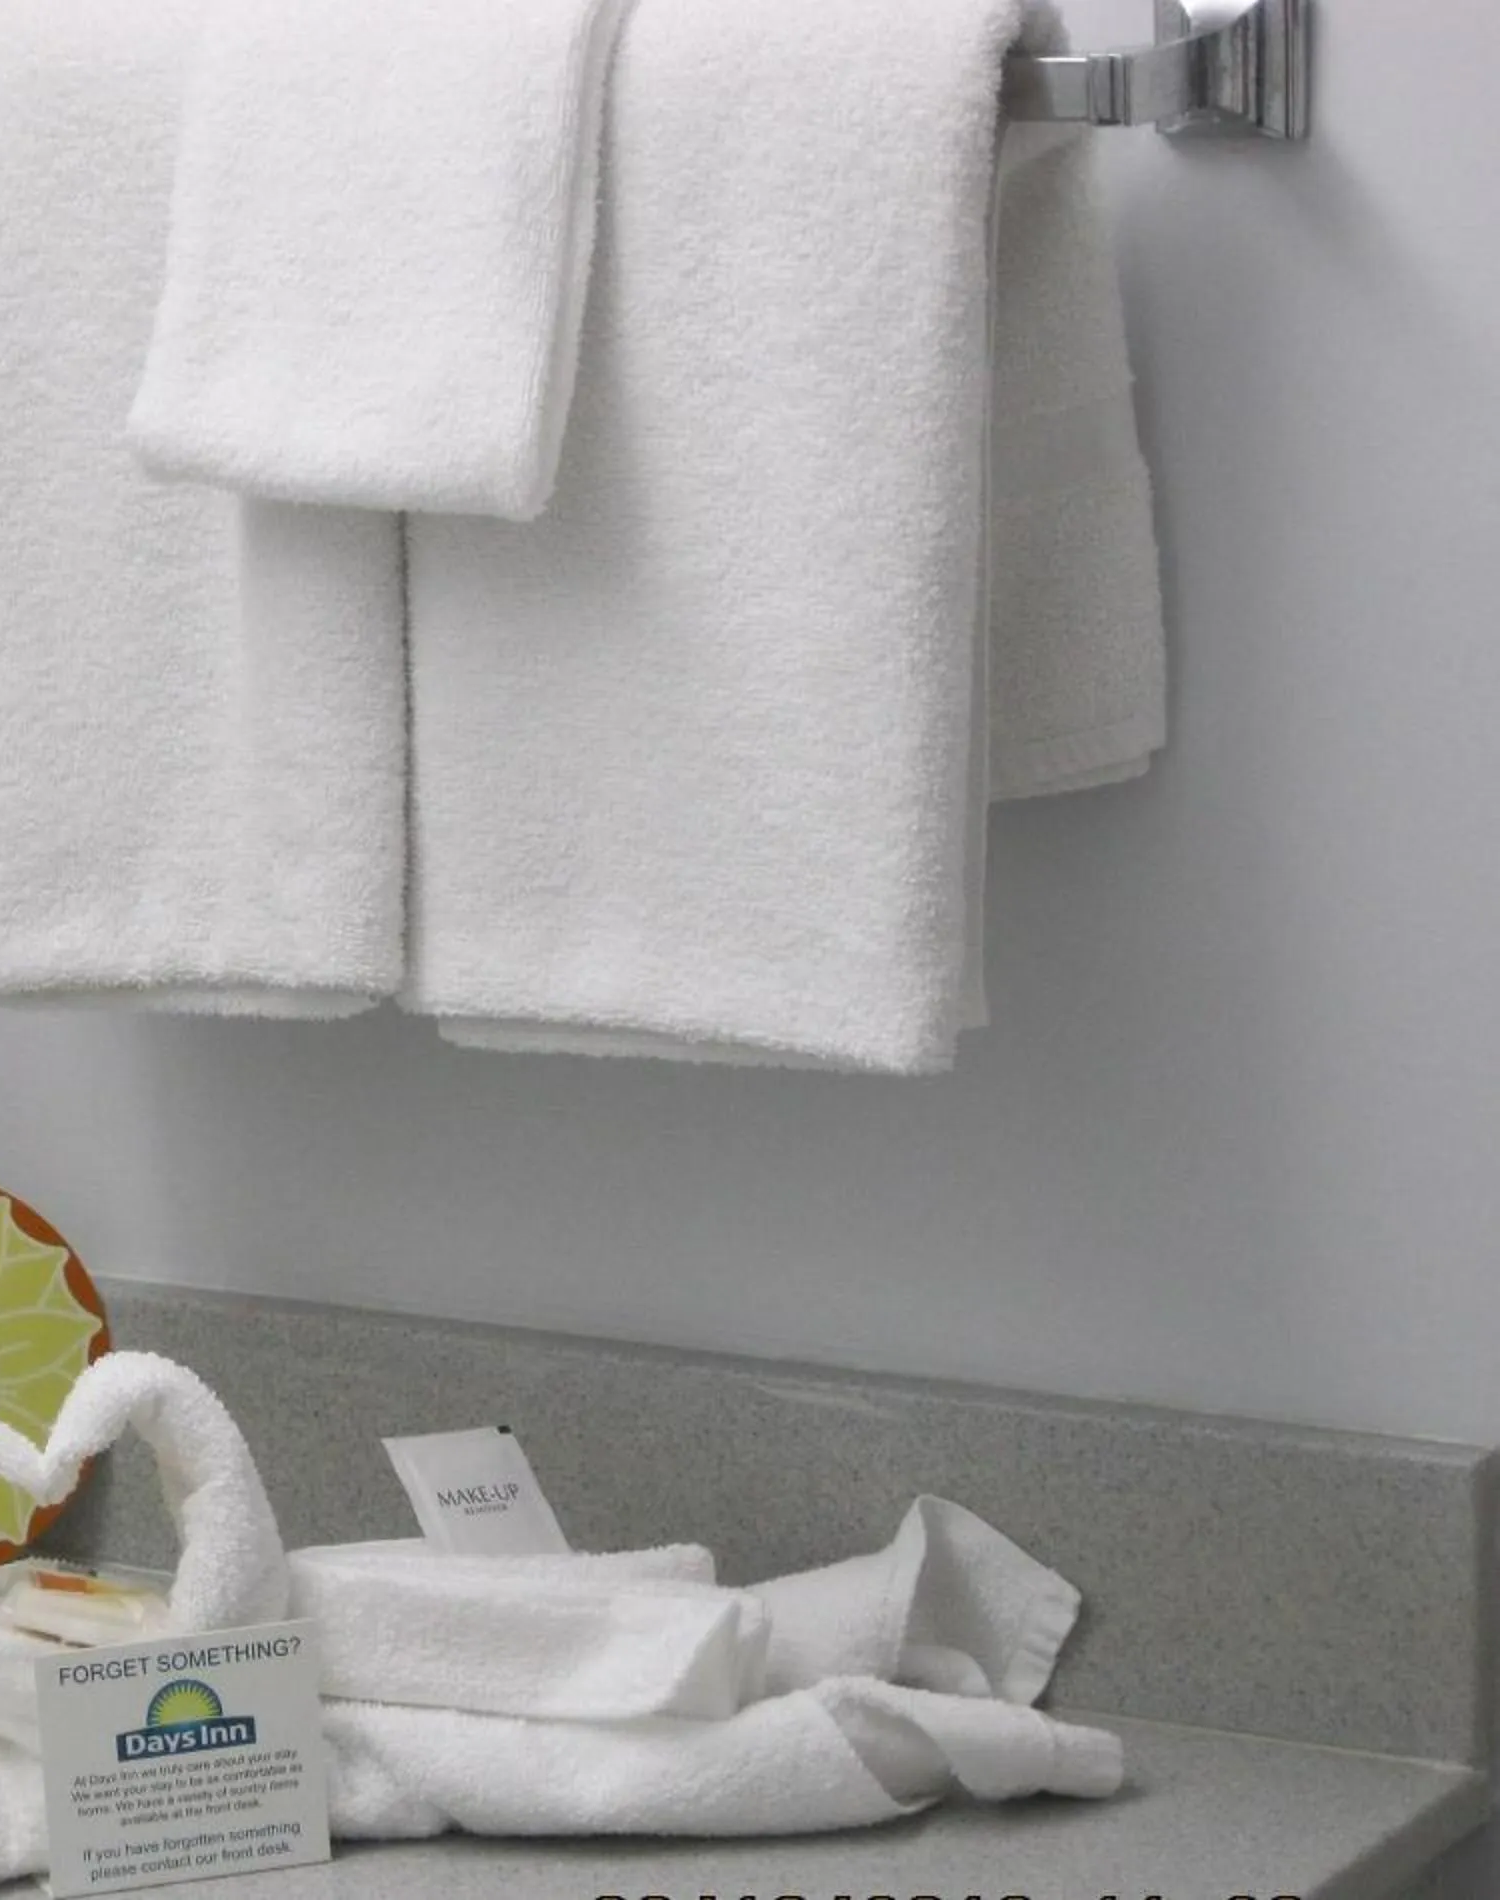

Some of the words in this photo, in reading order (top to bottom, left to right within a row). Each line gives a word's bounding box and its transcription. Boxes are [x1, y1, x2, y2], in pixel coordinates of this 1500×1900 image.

[437, 1482, 519, 1507] MAKE-UP
[59, 1657, 151, 1686] FORGET
[157, 1636, 301, 1673] SOMETHING?
[125, 1730, 197, 1756] Days
[201, 1723, 247, 1746] Inn
[91, 1864, 137, 1882] please
[141, 1855, 192, 1873] contact
[196, 1853, 218, 1865] our
[221, 1845, 254, 1859] front
[95, 1847, 121, 1862] you
[124, 1842, 160, 1857] have
[162, 1833, 225, 1852] forgotten
